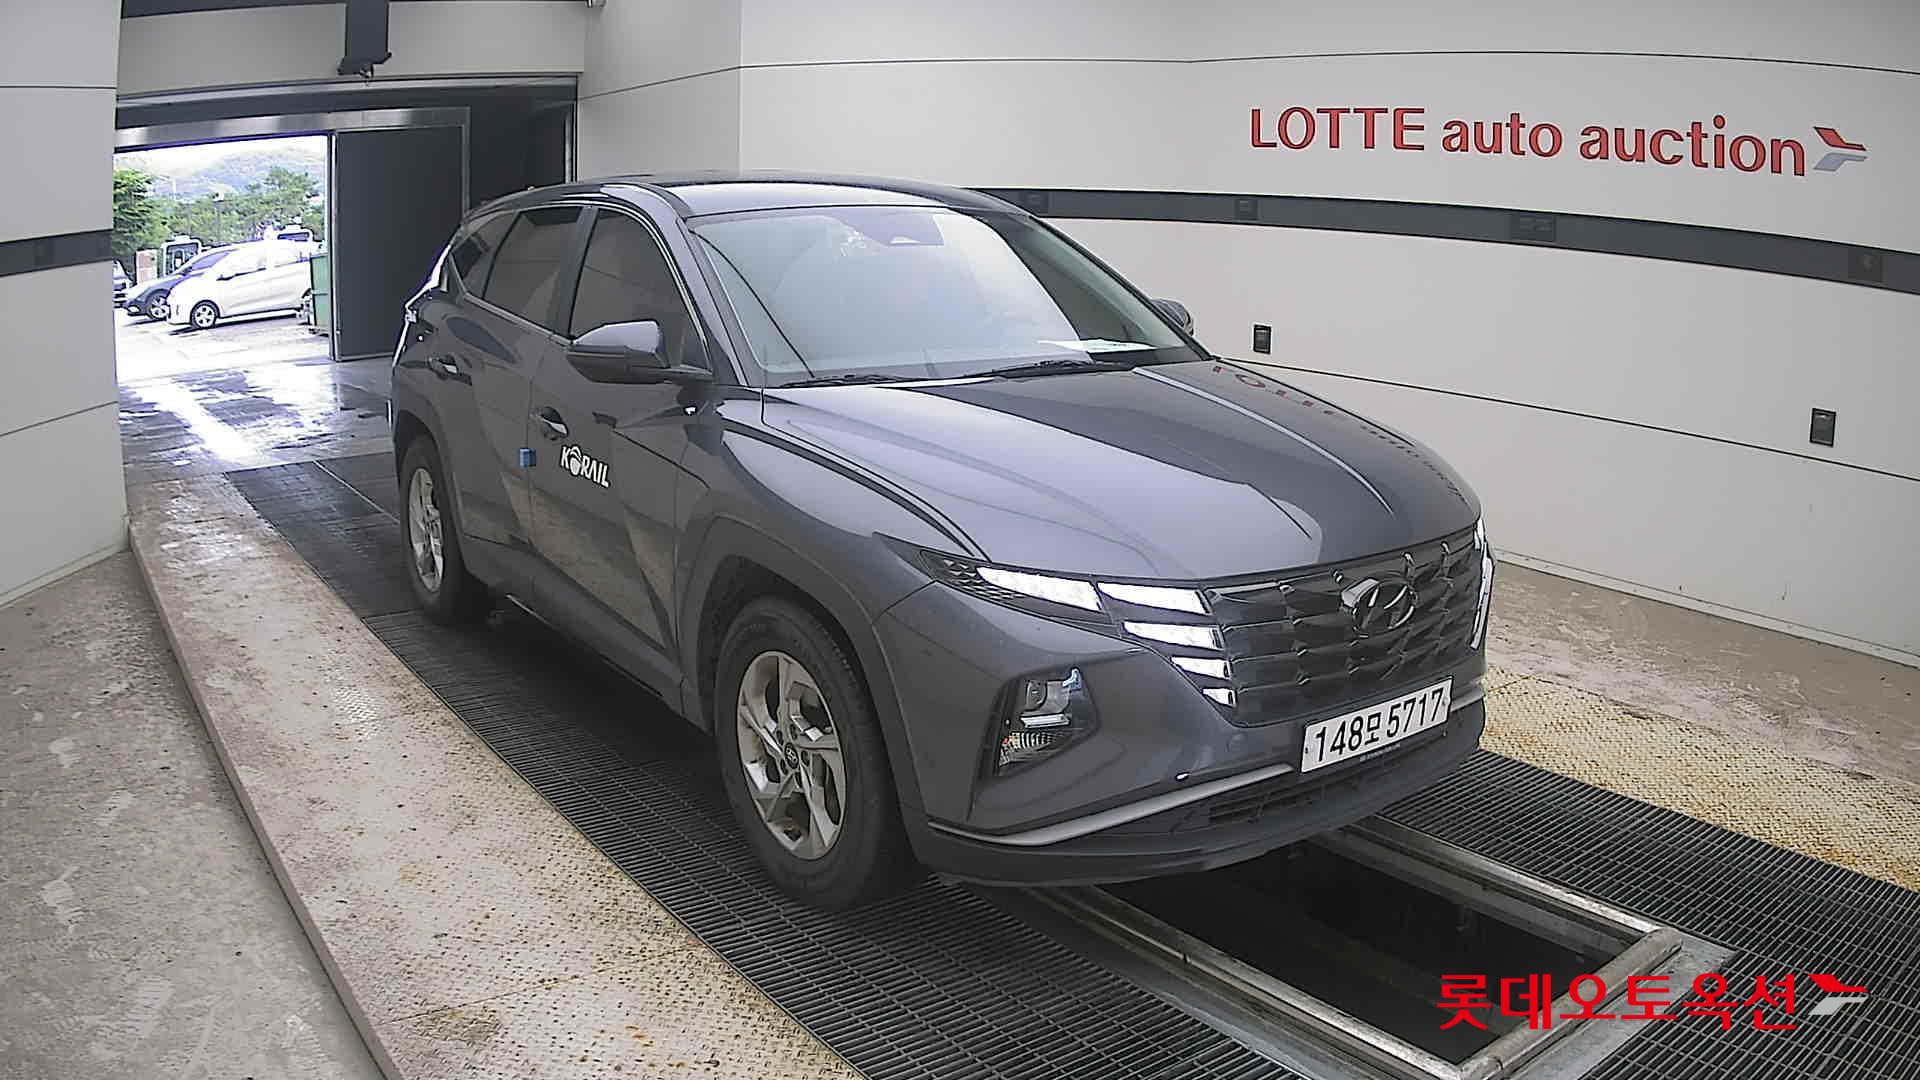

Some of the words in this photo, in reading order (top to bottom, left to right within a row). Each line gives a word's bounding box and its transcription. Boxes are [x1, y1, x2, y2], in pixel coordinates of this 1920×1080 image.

[1251, 106, 1425, 150] LOTTE
[1442, 112, 1563, 158] auto
[1579, 115, 1805, 177] auction
[560, 445, 610, 488] KORAIL
